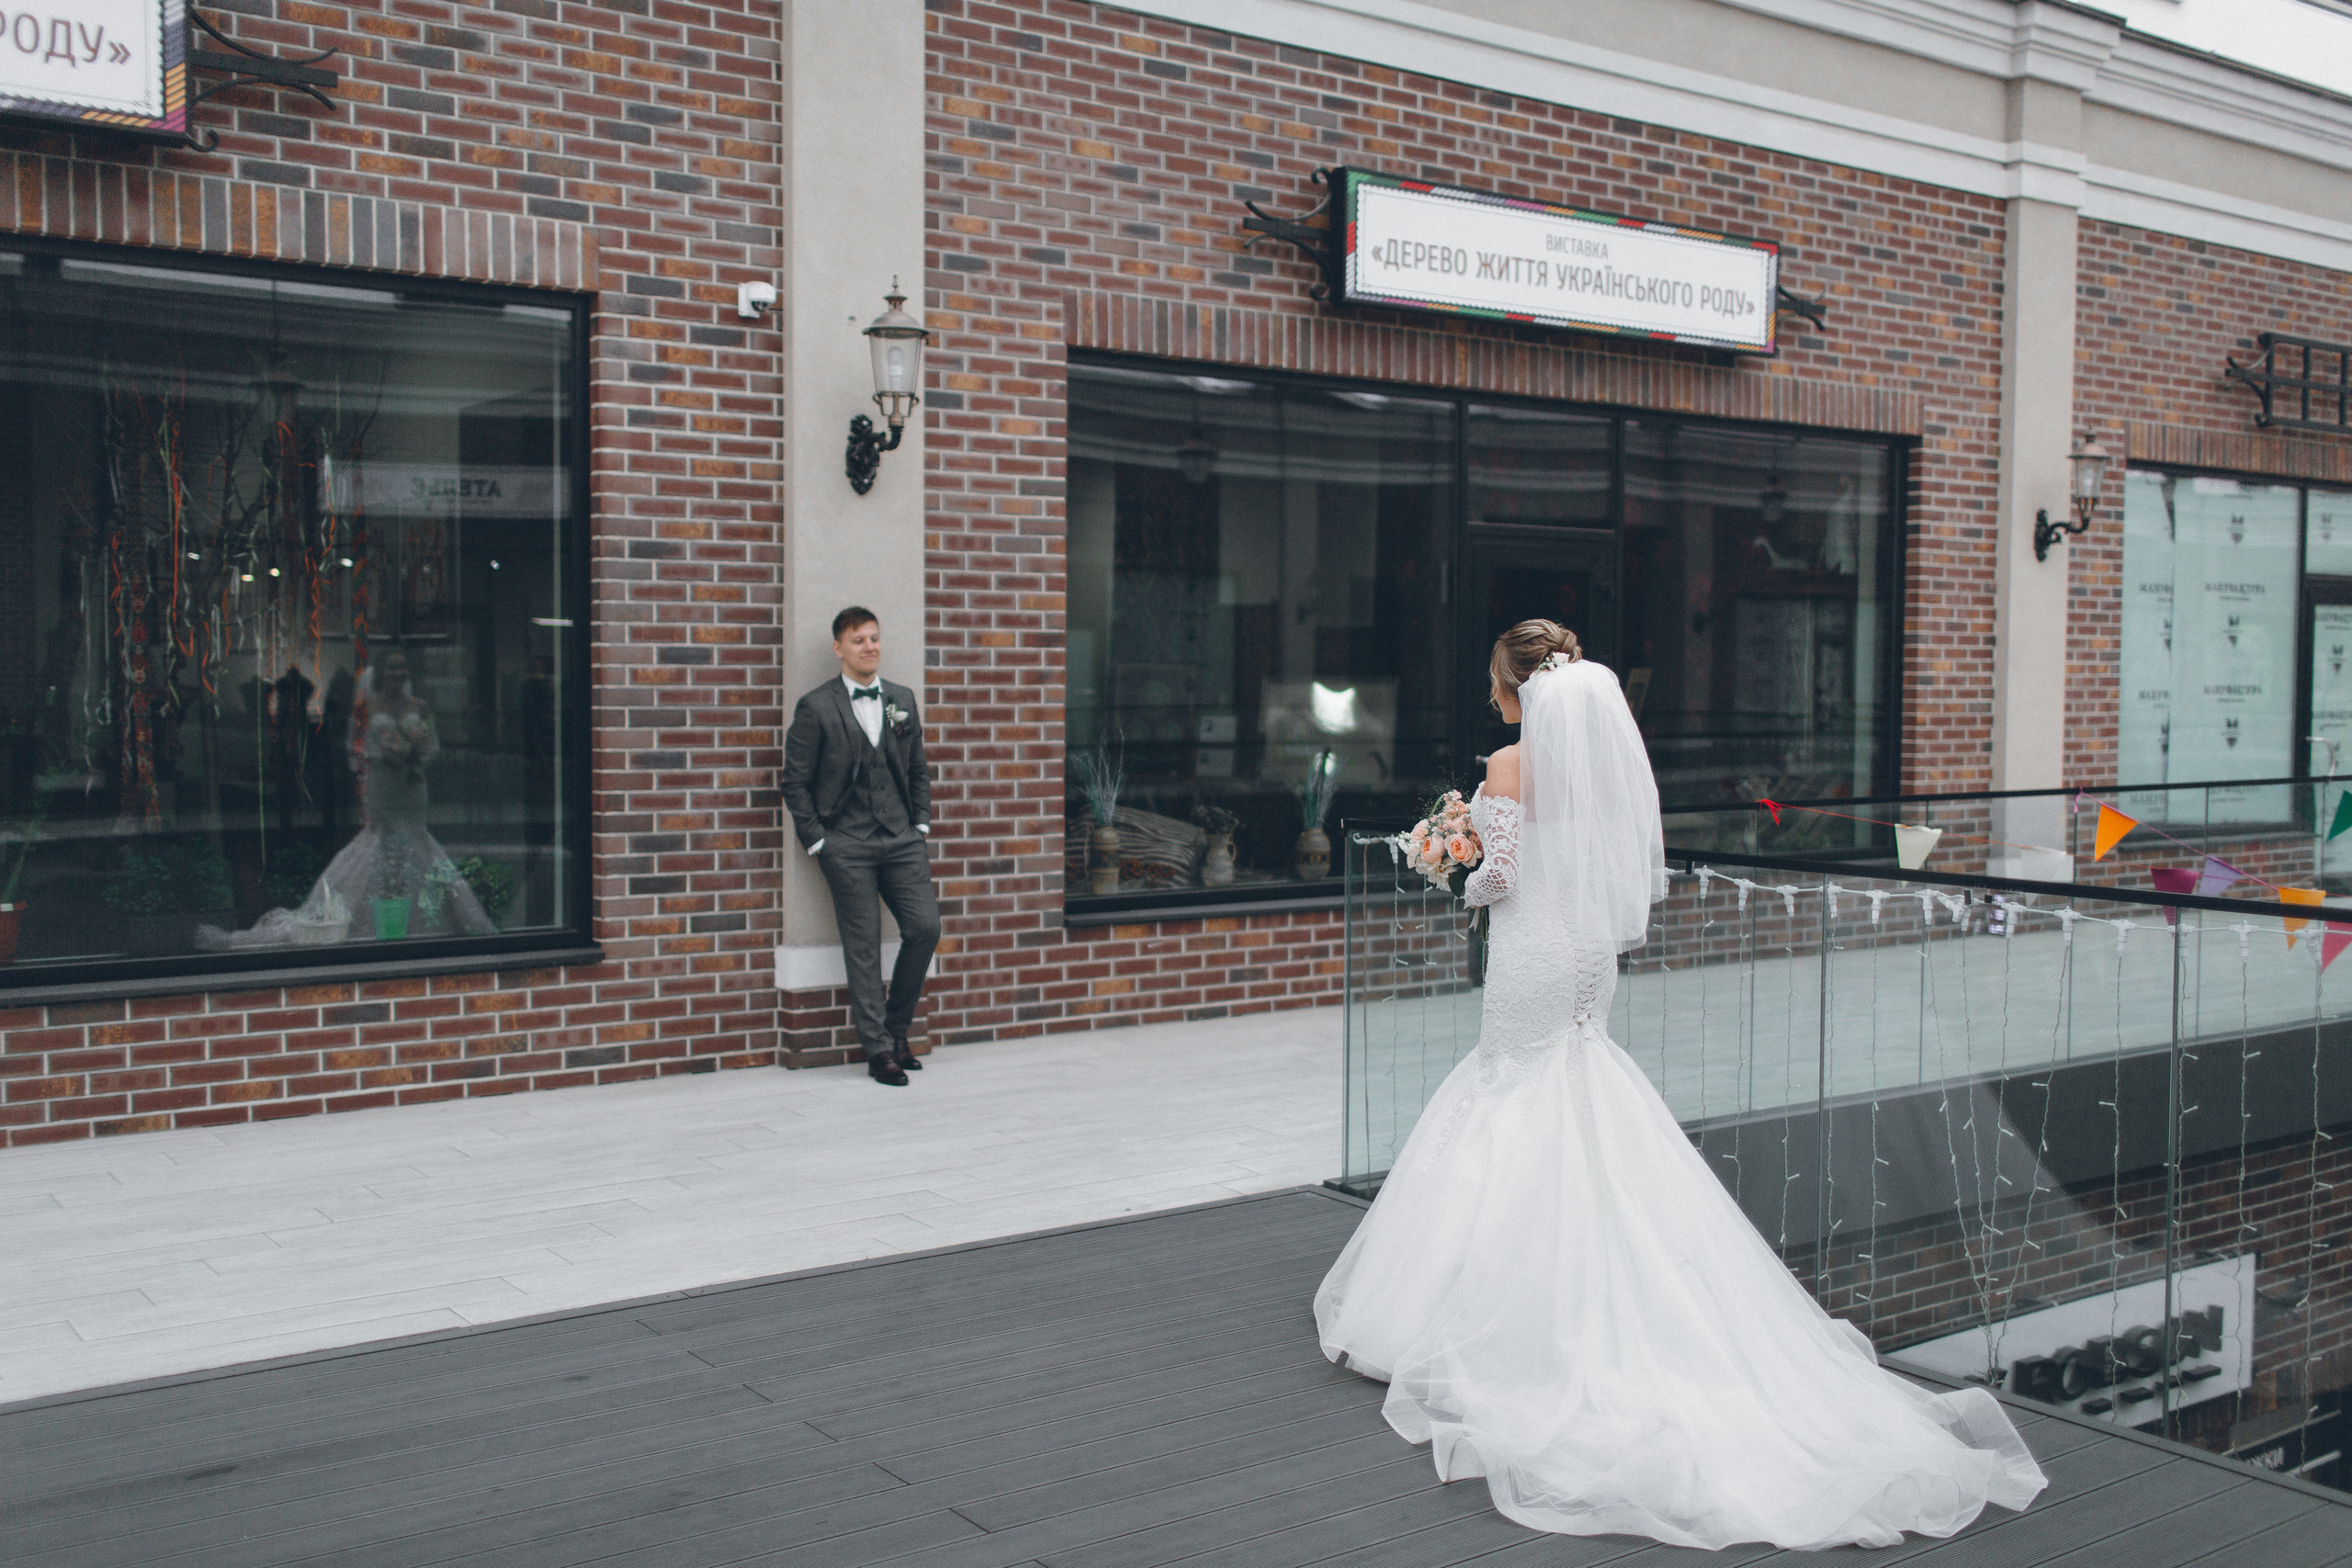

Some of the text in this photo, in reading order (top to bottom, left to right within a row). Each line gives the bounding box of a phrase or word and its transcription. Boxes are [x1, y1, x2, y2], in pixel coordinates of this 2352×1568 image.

[0, 10, 130, 68] ОДУ»
[1545, 233, 1609, 260] ВИСТАВКА
[1371, 238, 1755, 319] «ДЕРЕВО ЖИТТЯ УКРАЇНСЬКОГО РОДУ»
